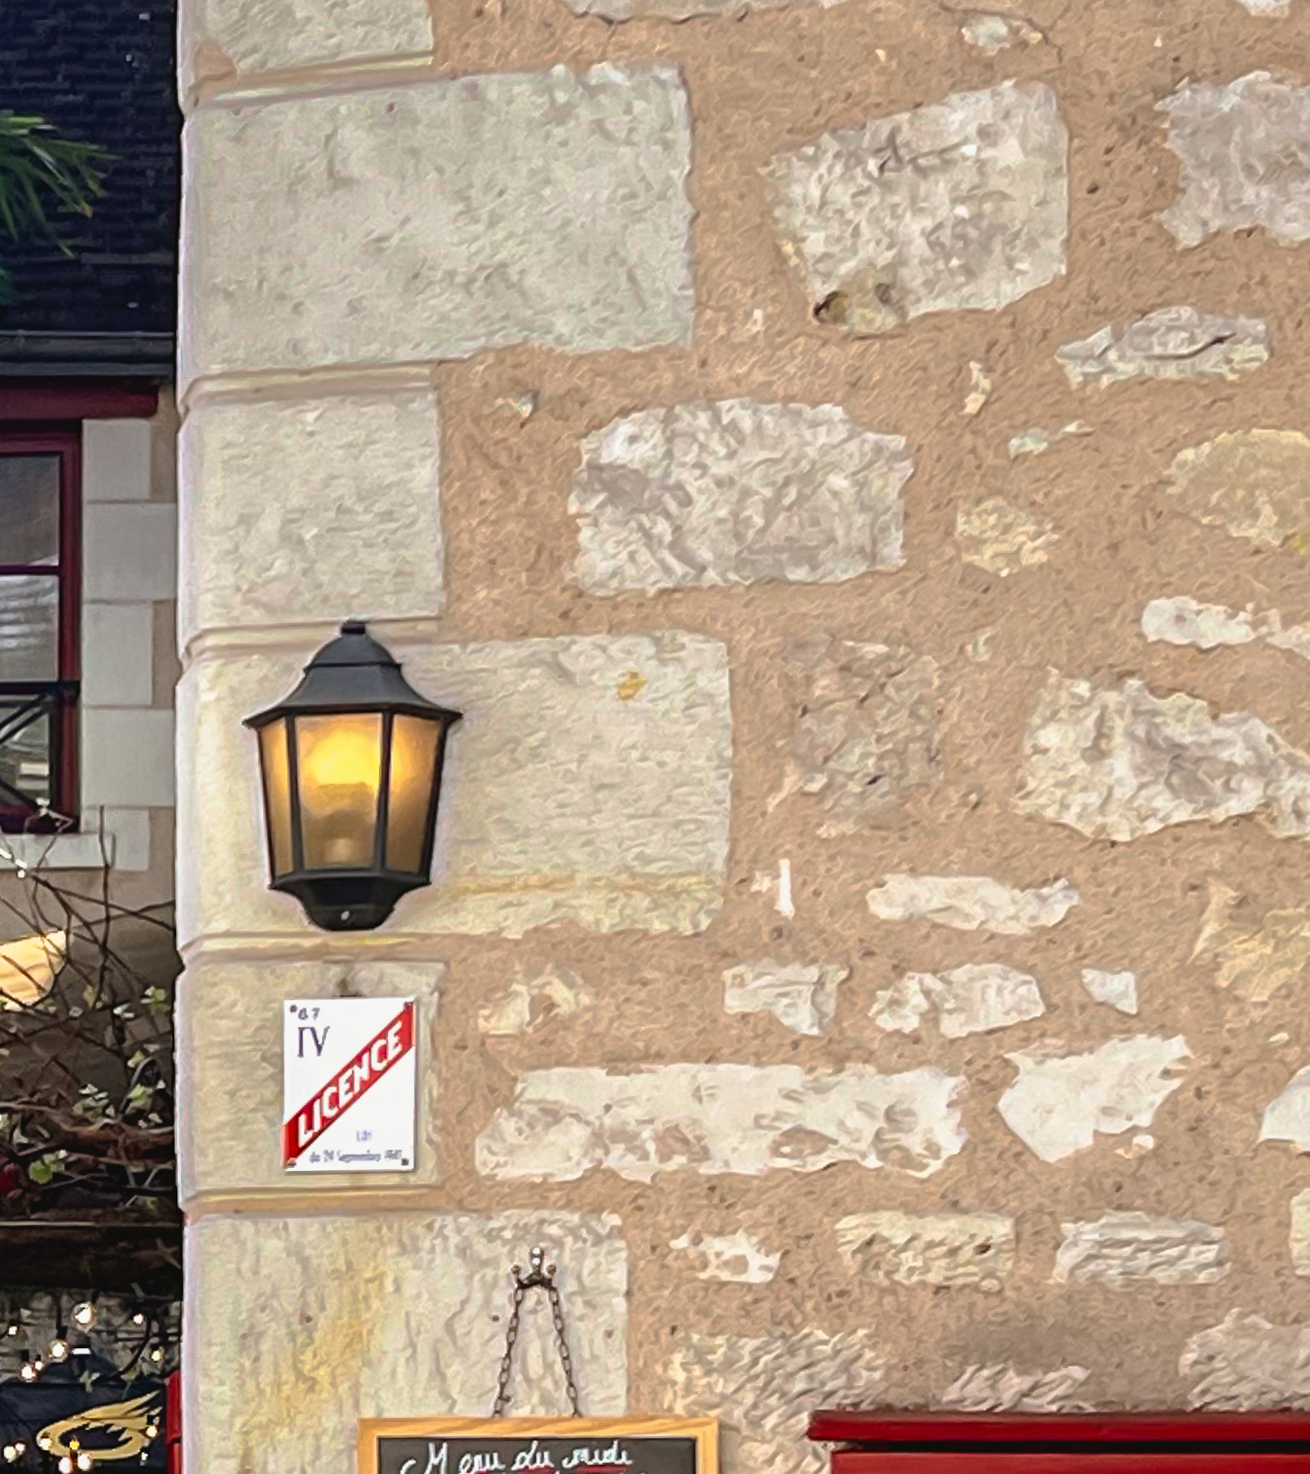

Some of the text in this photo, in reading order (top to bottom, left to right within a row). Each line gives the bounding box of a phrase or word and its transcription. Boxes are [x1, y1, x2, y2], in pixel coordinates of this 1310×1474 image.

[296, 1026, 331, 1058] IV
[297, 1020, 404, 1149] LICENCE
[511, 1439, 555, 1470] du
